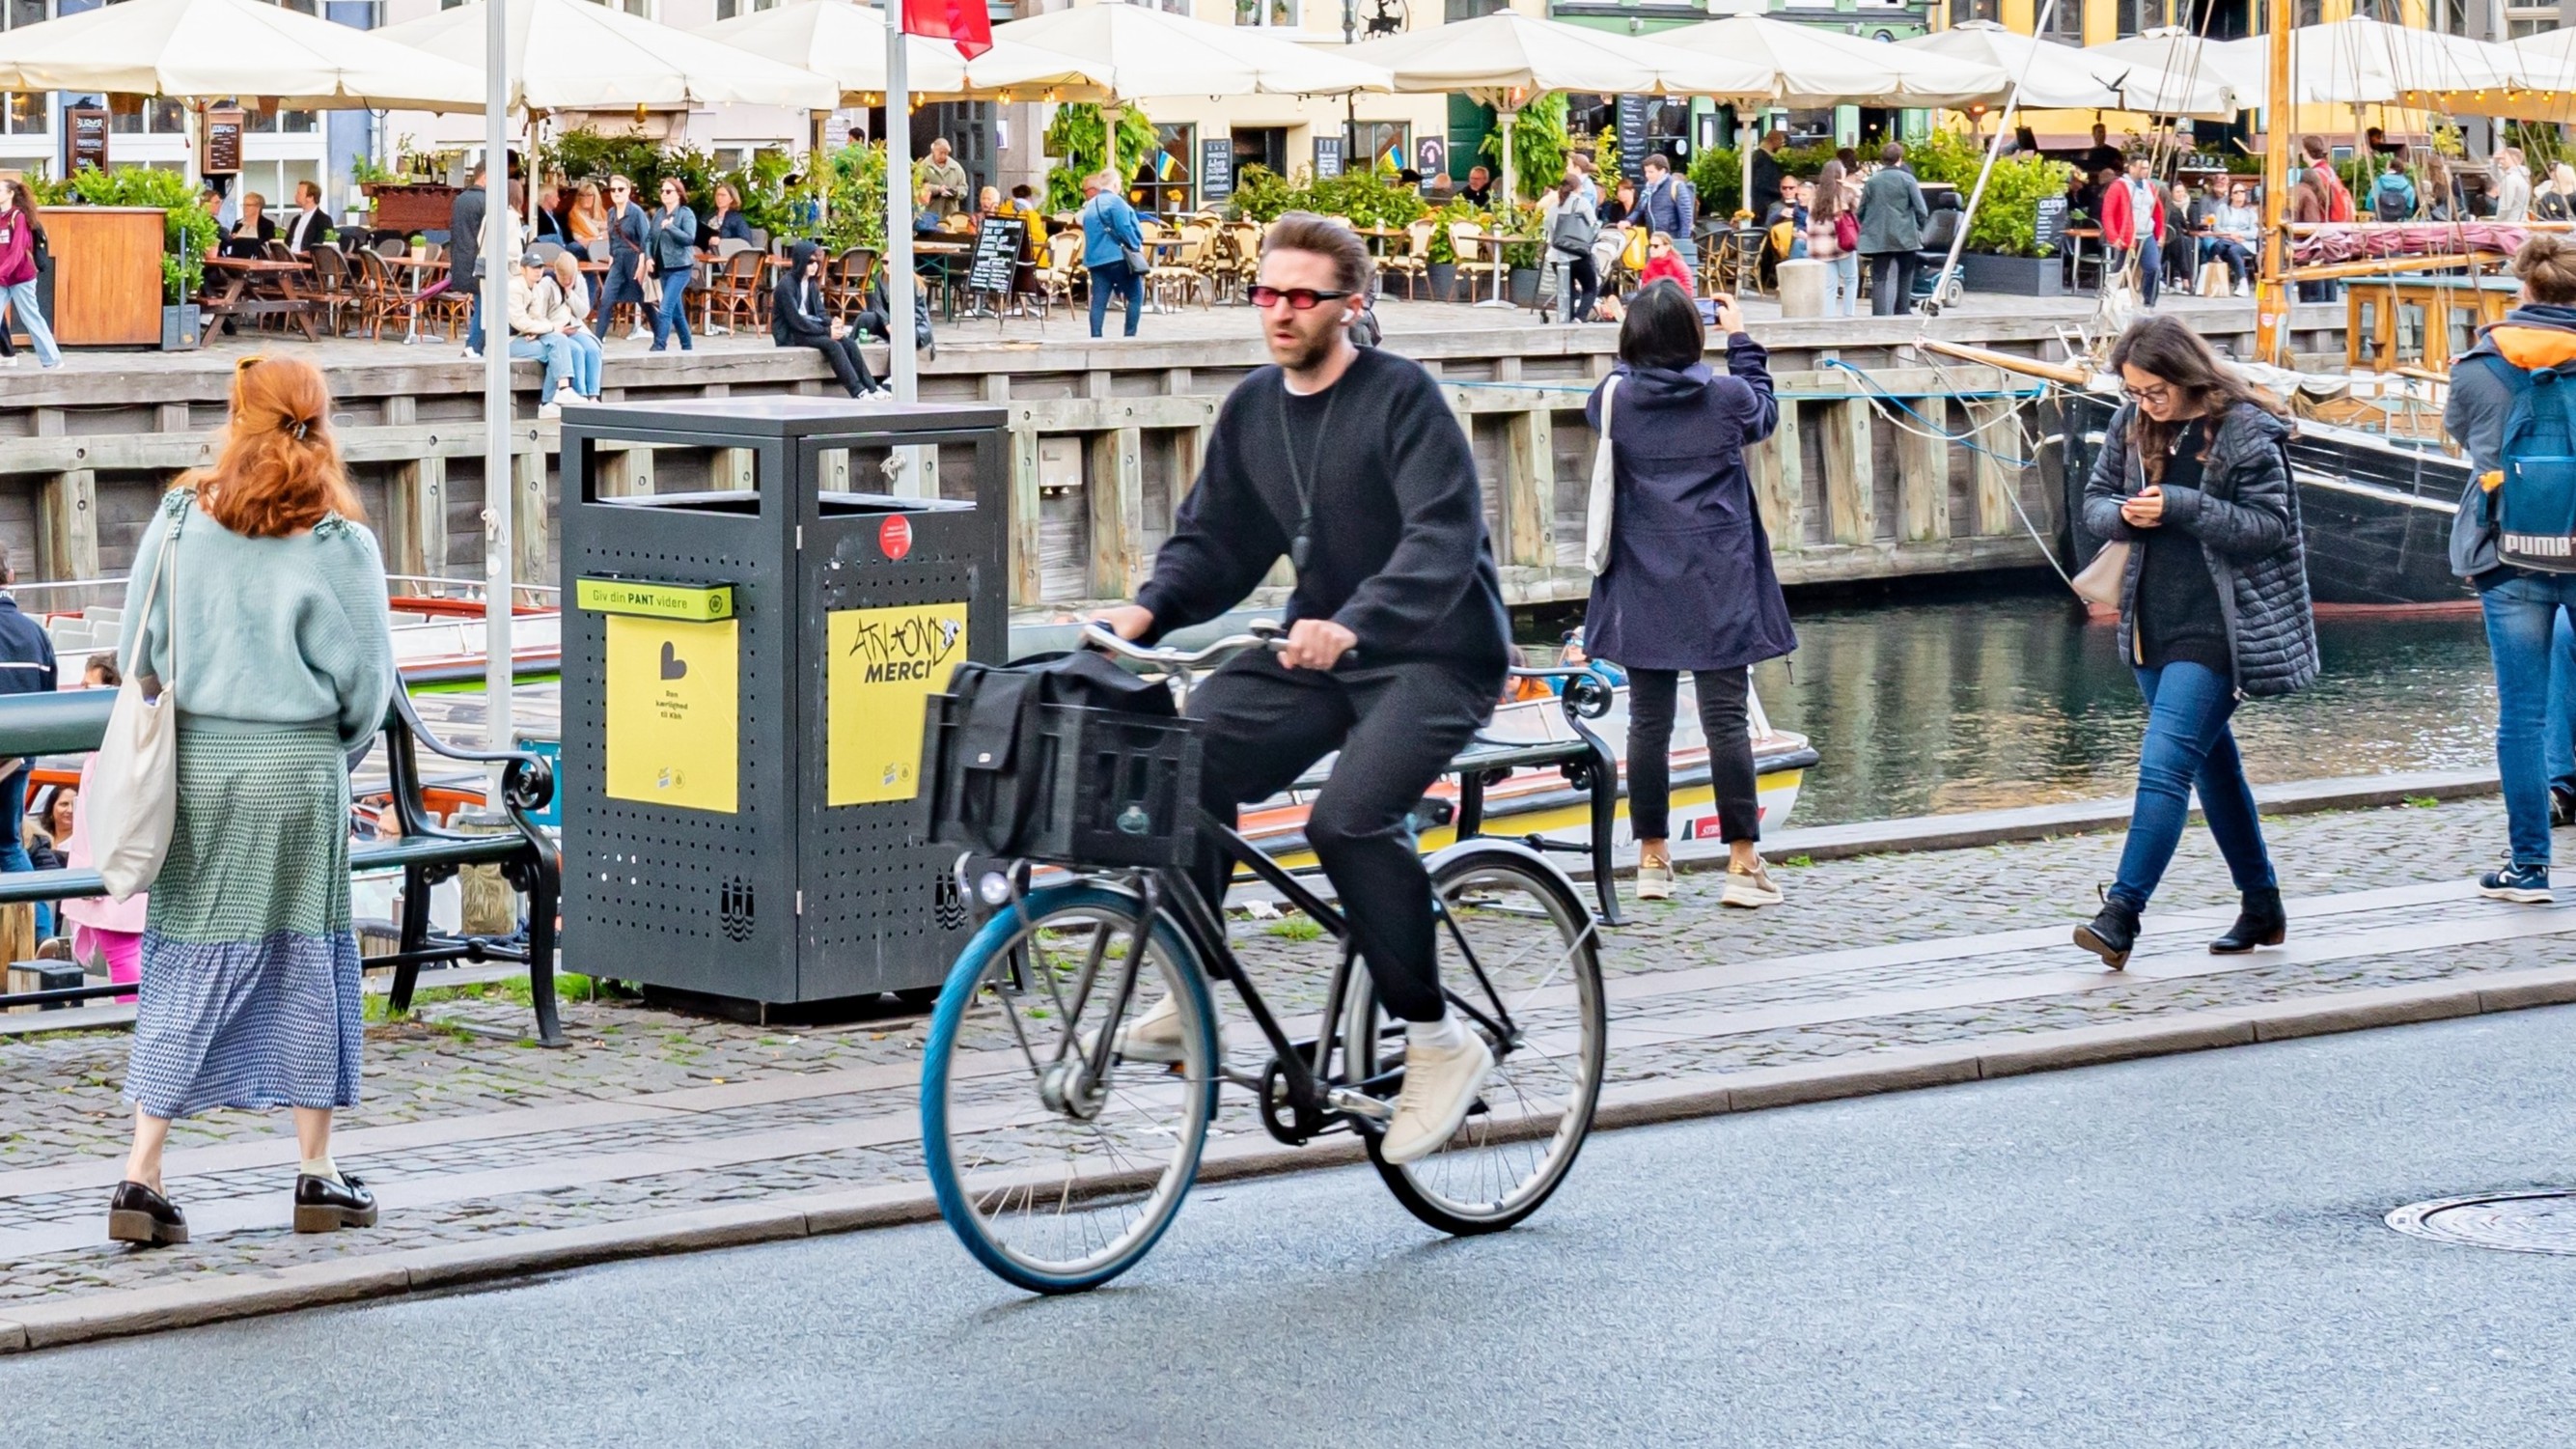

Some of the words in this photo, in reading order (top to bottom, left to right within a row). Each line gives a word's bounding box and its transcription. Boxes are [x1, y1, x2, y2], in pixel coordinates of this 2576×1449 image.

[2504, 534, 2572, 557] PUMA
[593, 589, 608, 600] Giv
[610, 591, 625, 602] din
[627, 593, 654, 605] PANT
[656, 596, 688, 609] videre
[864, 659, 931, 683] MERCI
